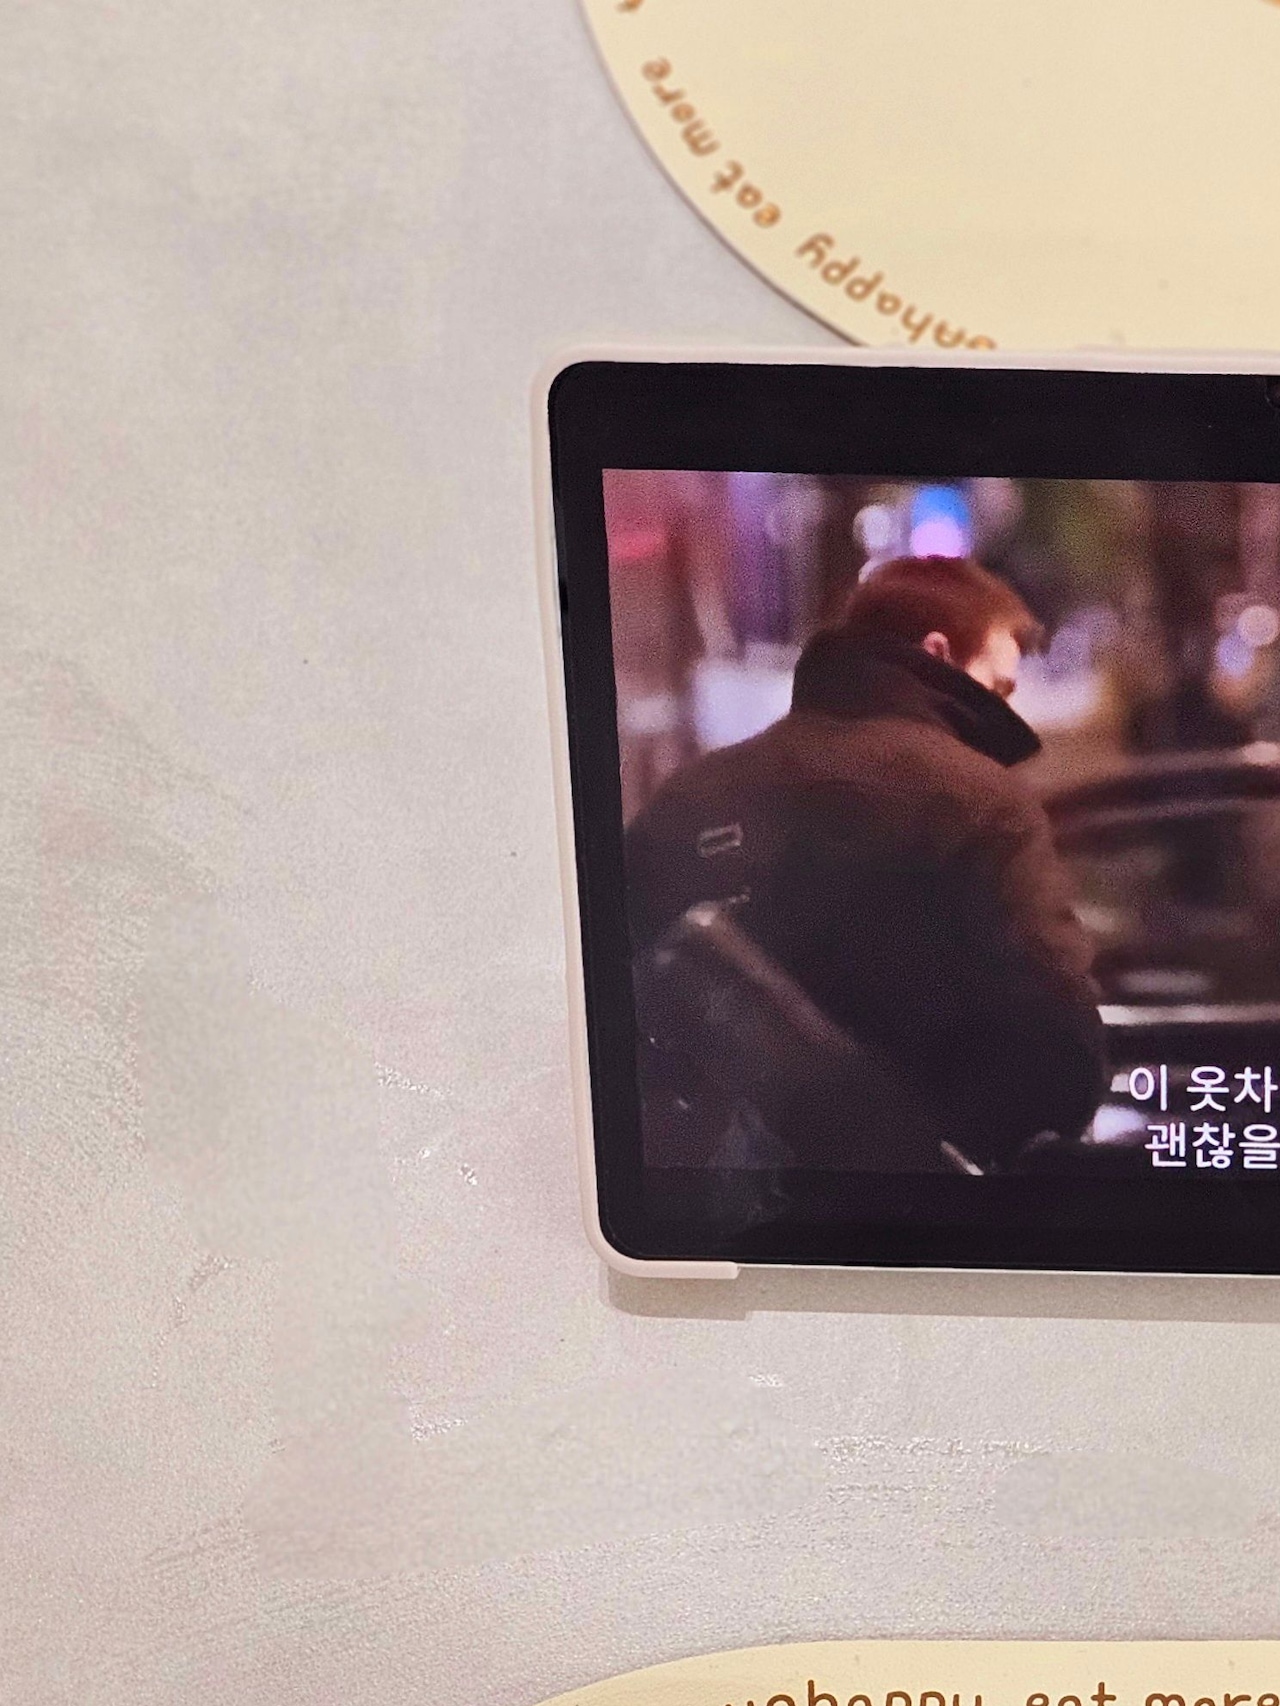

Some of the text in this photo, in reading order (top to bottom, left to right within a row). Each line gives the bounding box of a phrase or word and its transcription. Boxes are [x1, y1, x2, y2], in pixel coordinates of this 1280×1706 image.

[641, 56, 721, 157] more
[709, 160, 782, 228] eat
[1128, 1064, 1168, 1112] 이
